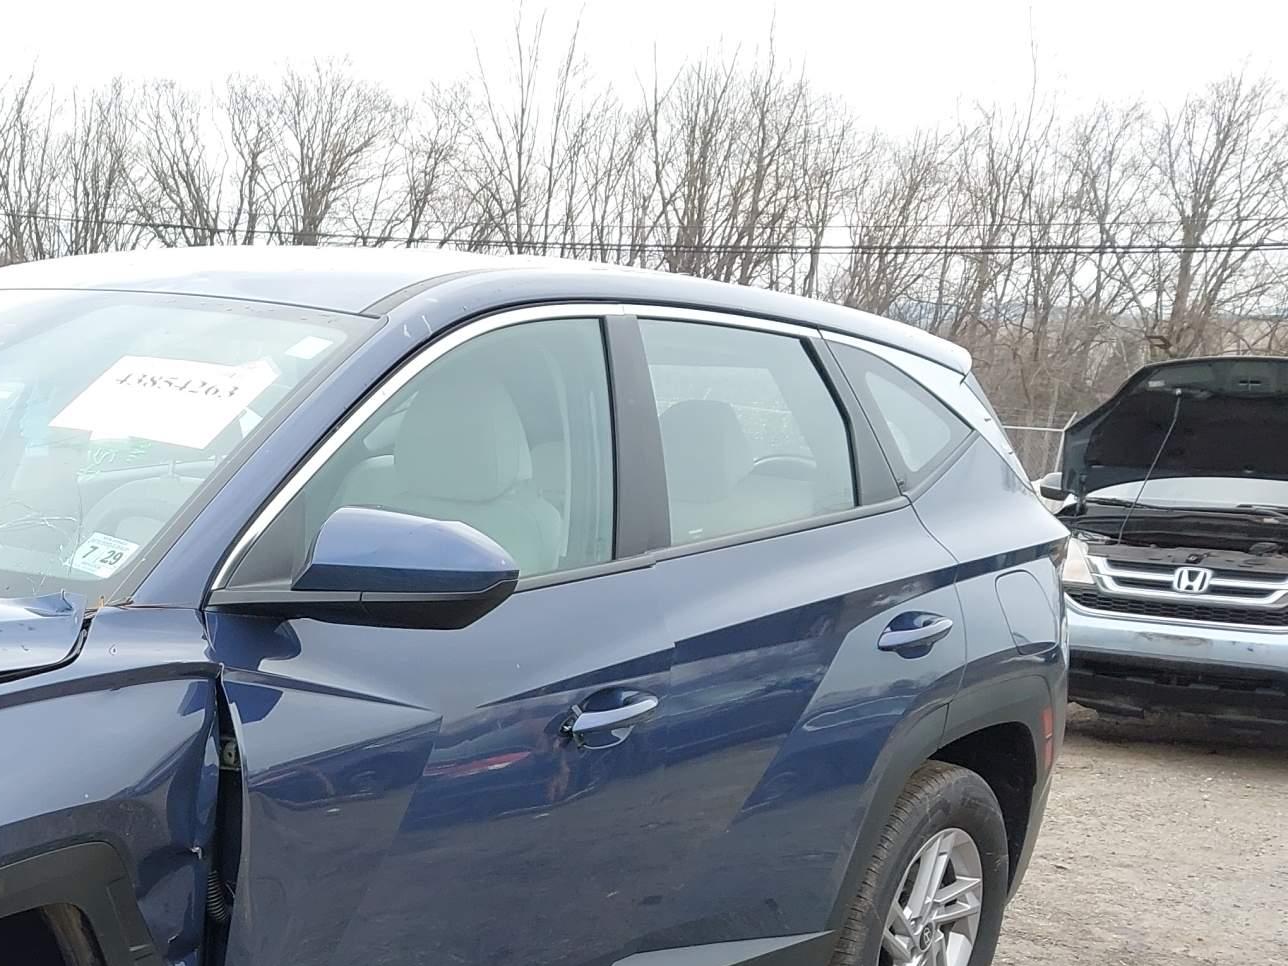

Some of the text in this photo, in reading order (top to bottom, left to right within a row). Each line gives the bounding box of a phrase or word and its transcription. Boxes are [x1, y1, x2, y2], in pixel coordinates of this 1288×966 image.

[115, 373, 239, 398] 43854263
[82, 545, 99, 559] 7
[99, 549, 124, 566] 29
